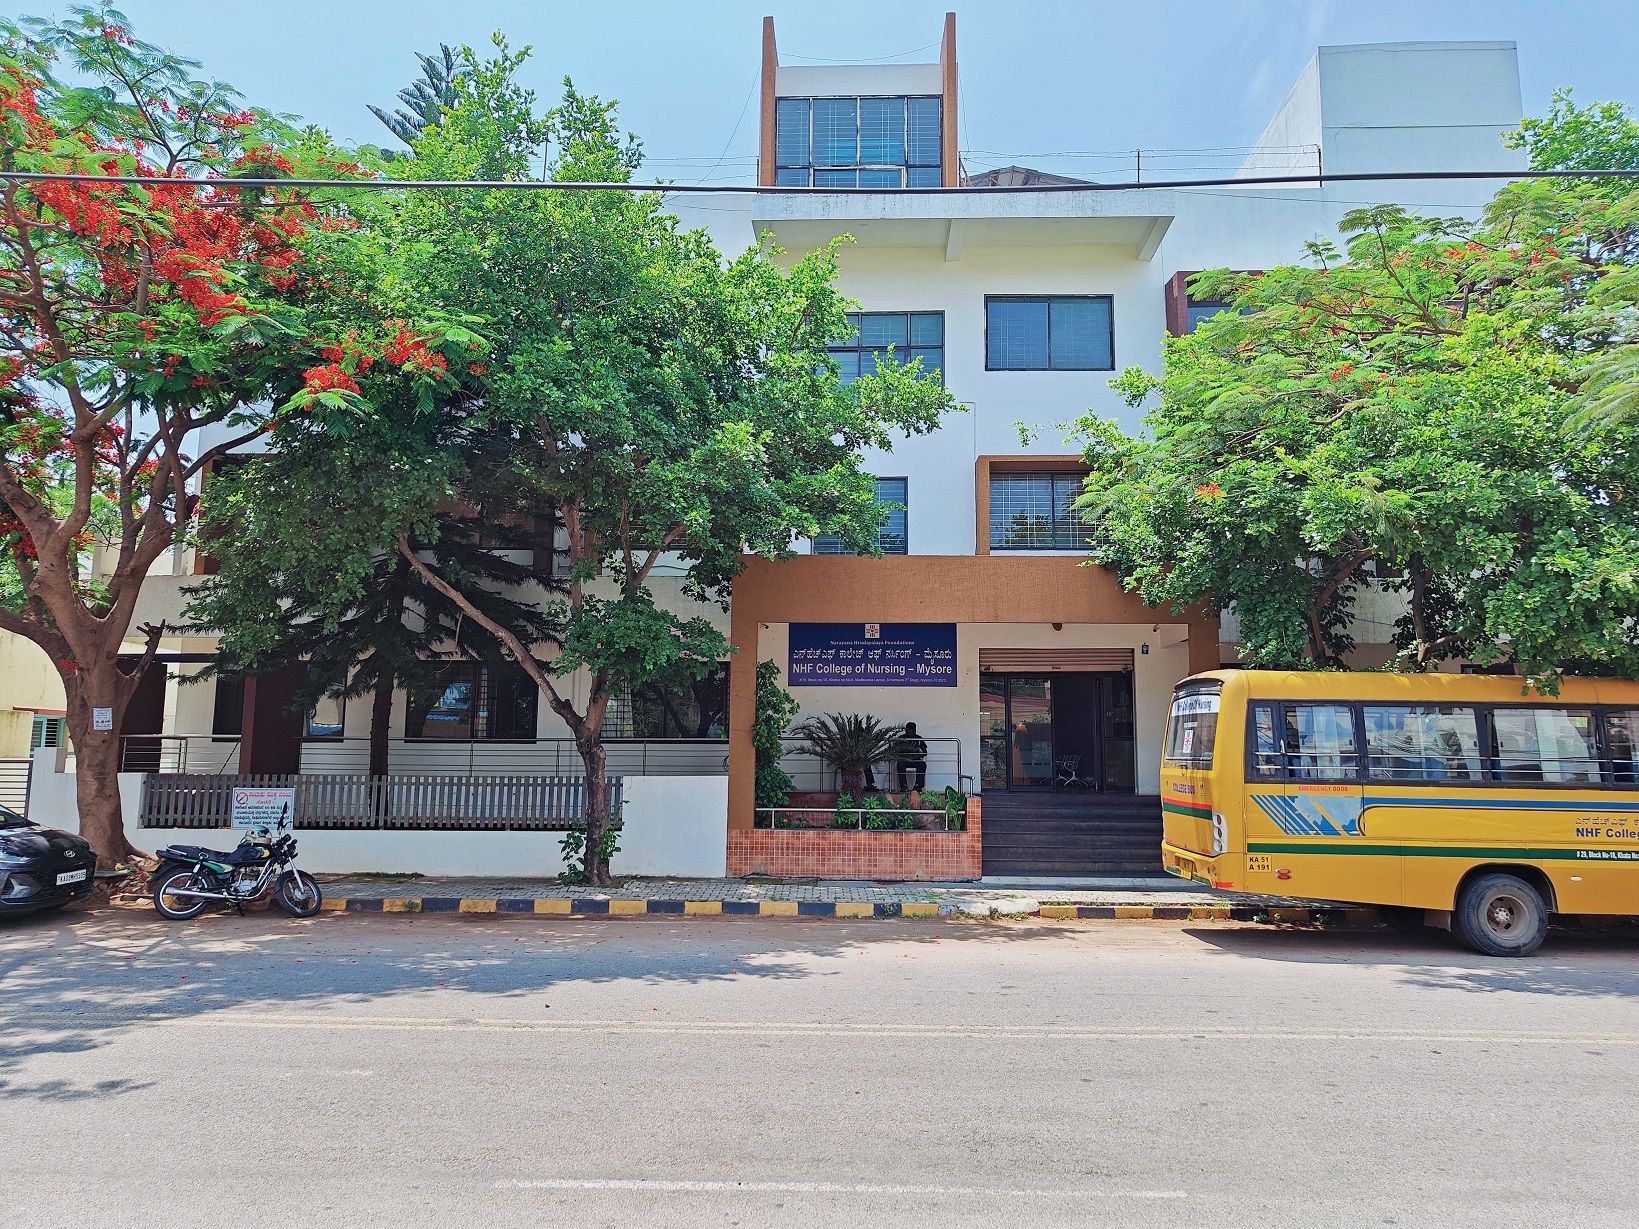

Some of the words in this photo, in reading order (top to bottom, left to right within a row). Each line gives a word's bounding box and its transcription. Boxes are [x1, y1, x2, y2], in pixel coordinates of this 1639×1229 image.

[793, 663, 813, 673] NHF
[816, 663, 852, 676] College
[855, 663, 866, 673] of
[867, 663, 906, 676] Nursing
[916, 663, 952, 676] Mysore
[1576, 828, 1601, 837] NHF
